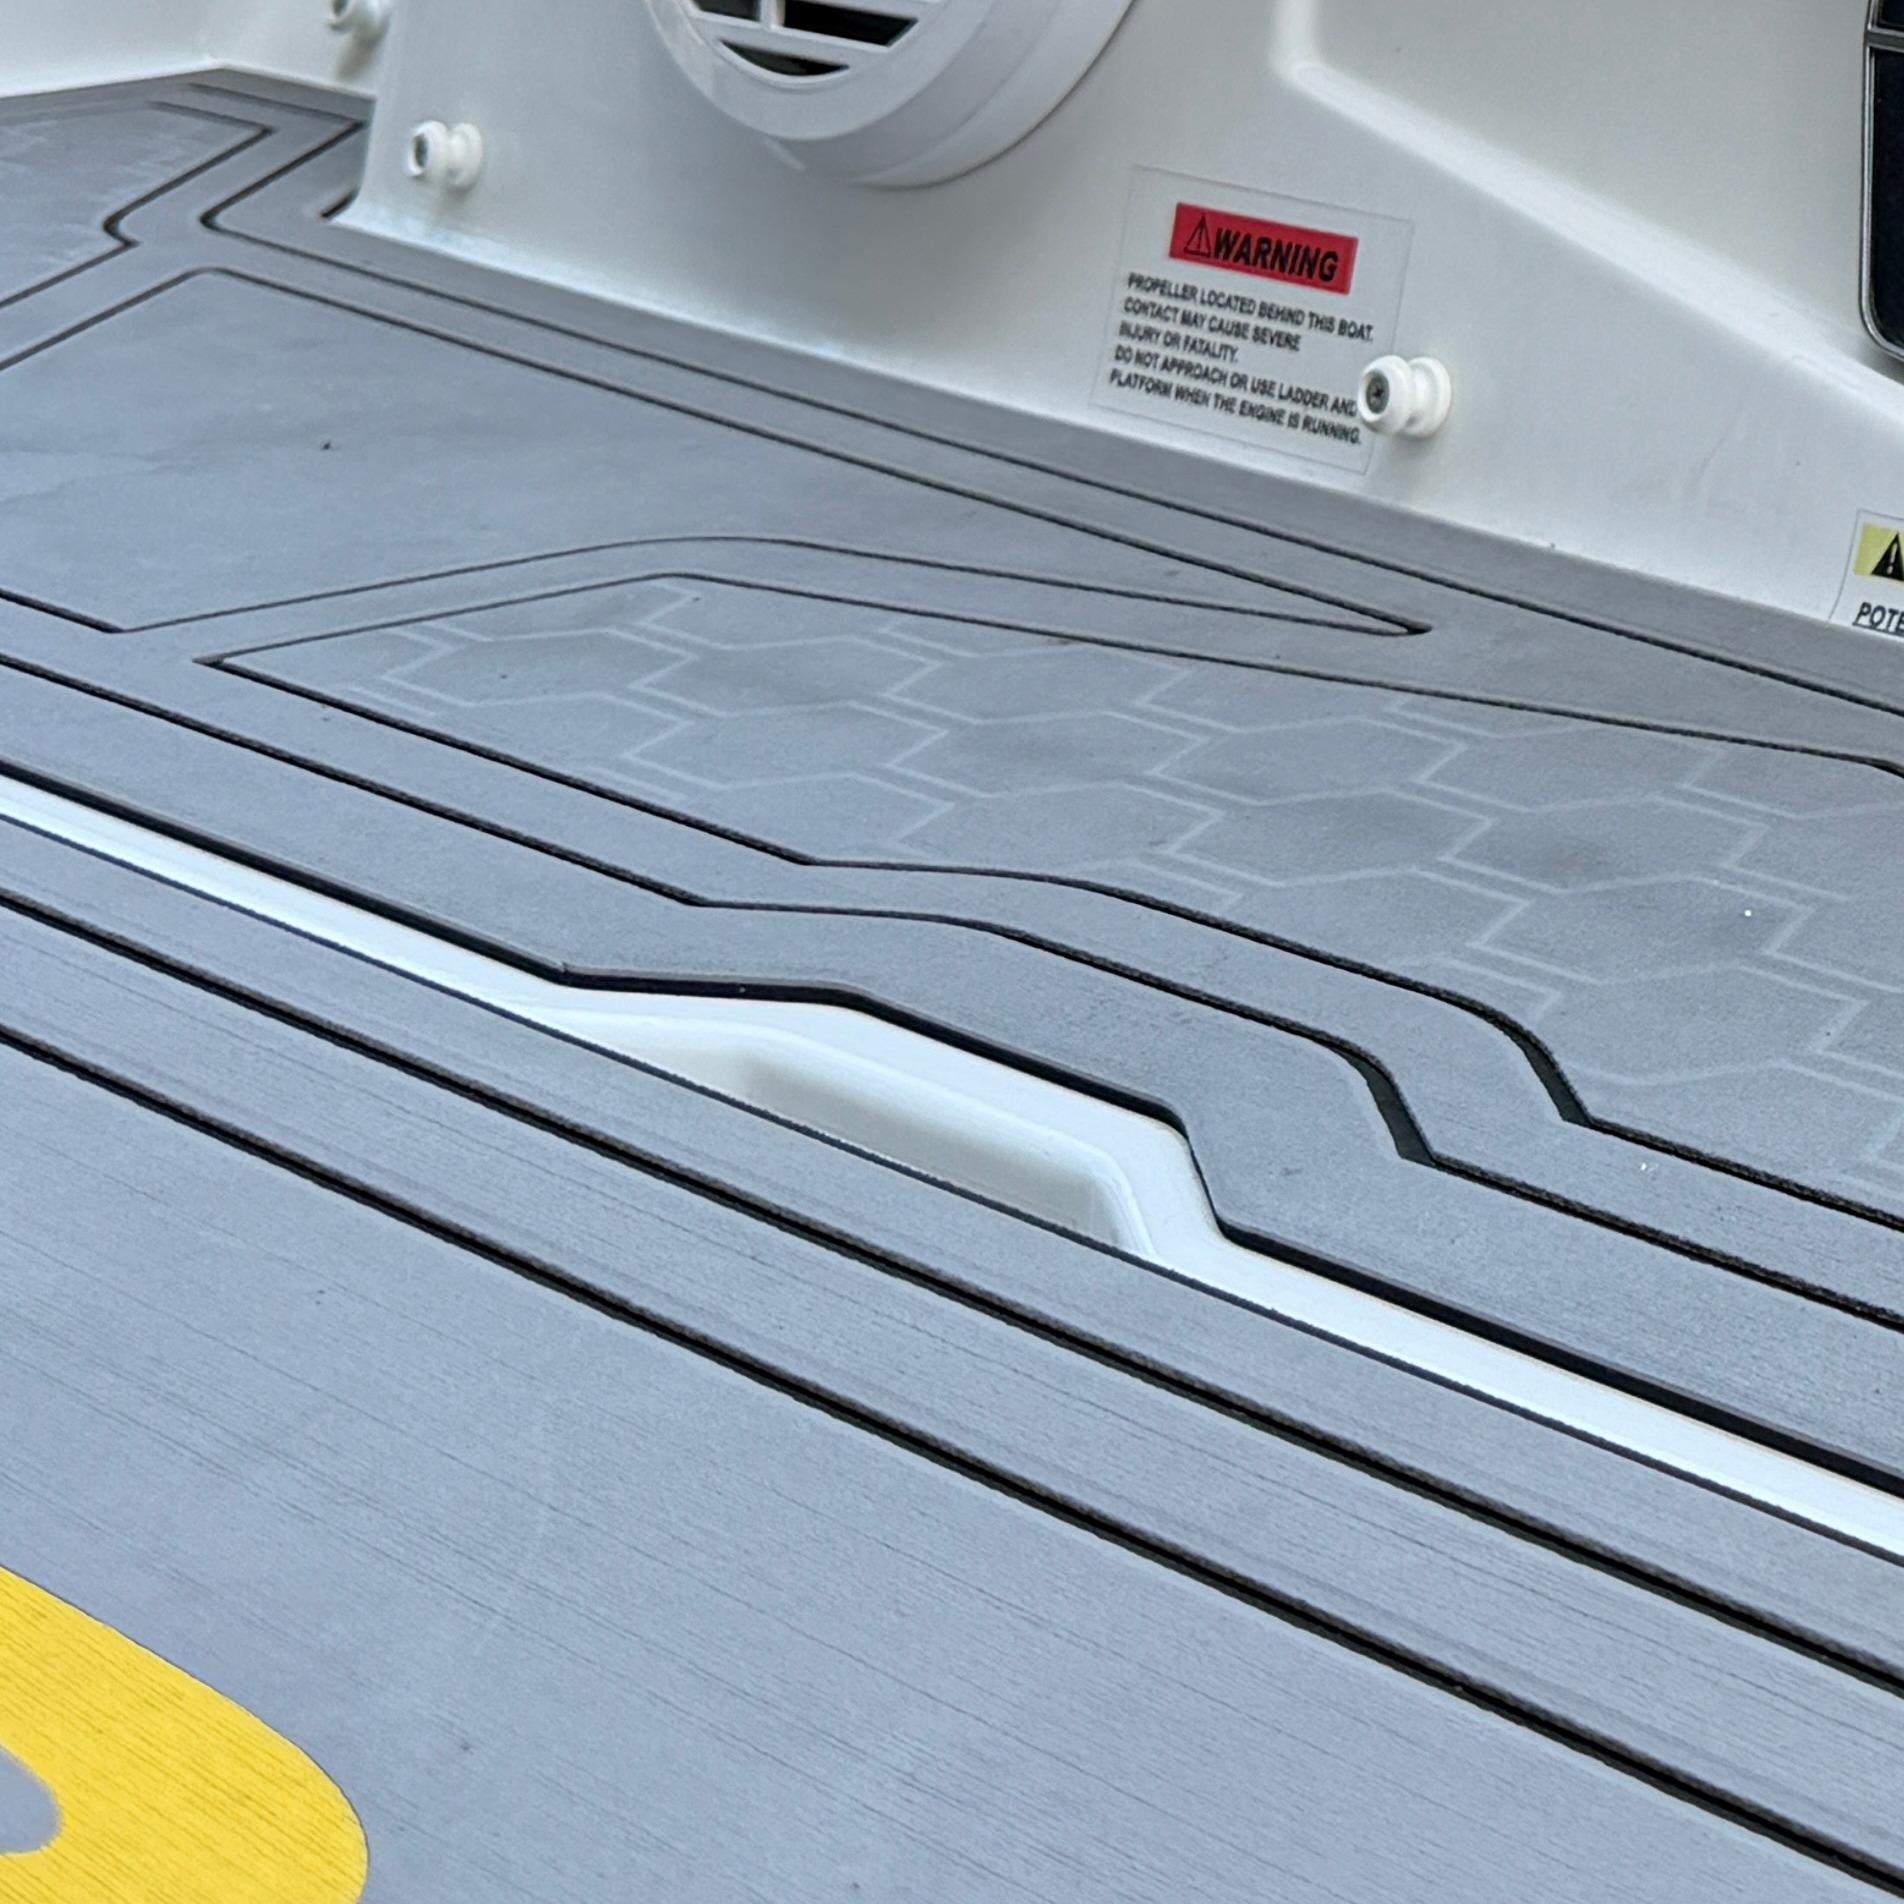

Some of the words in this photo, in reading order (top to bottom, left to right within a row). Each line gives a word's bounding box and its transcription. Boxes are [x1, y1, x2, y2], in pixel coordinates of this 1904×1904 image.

[1213, 227, 1339, 283] WARNING
[1124, 296, 1179, 322] CONTACT
[1180, 309, 1206, 328] MAY
[1208, 315, 1249, 340] CAUSE
[1252, 326, 1301, 352] SEVERE
[1128, 272, 1198, 301] PROPELLER
[1200, 288, 1255, 315] LOCATED
[1258, 301, 1305, 326] BEHIND
[1308, 311, 1335, 333] THIS
[1119, 320, 1161, 344] INJURY
[1163, 330, 1180, 349] OR
[1110, 368, 1173, 397] PLATFORM
[1175, 384, 1211, 407] WHEN
[1214, 393, 1237, 414] THE
[1238, 400, 1286, 426] ENGINE
[1288, 411, 1300, 429] IS
[1115, 344, 1132, 363] DO
[1135, 349, 1160, 370] NOT
[1160, 356, 1228, 386] APPROACH
[1230, 372, 1249, 392] OR
[1250, 376, 1276, 397] USE
[1278, 382, 1330, 411] LADDER
[1330, 398, 1358, 417] AND
